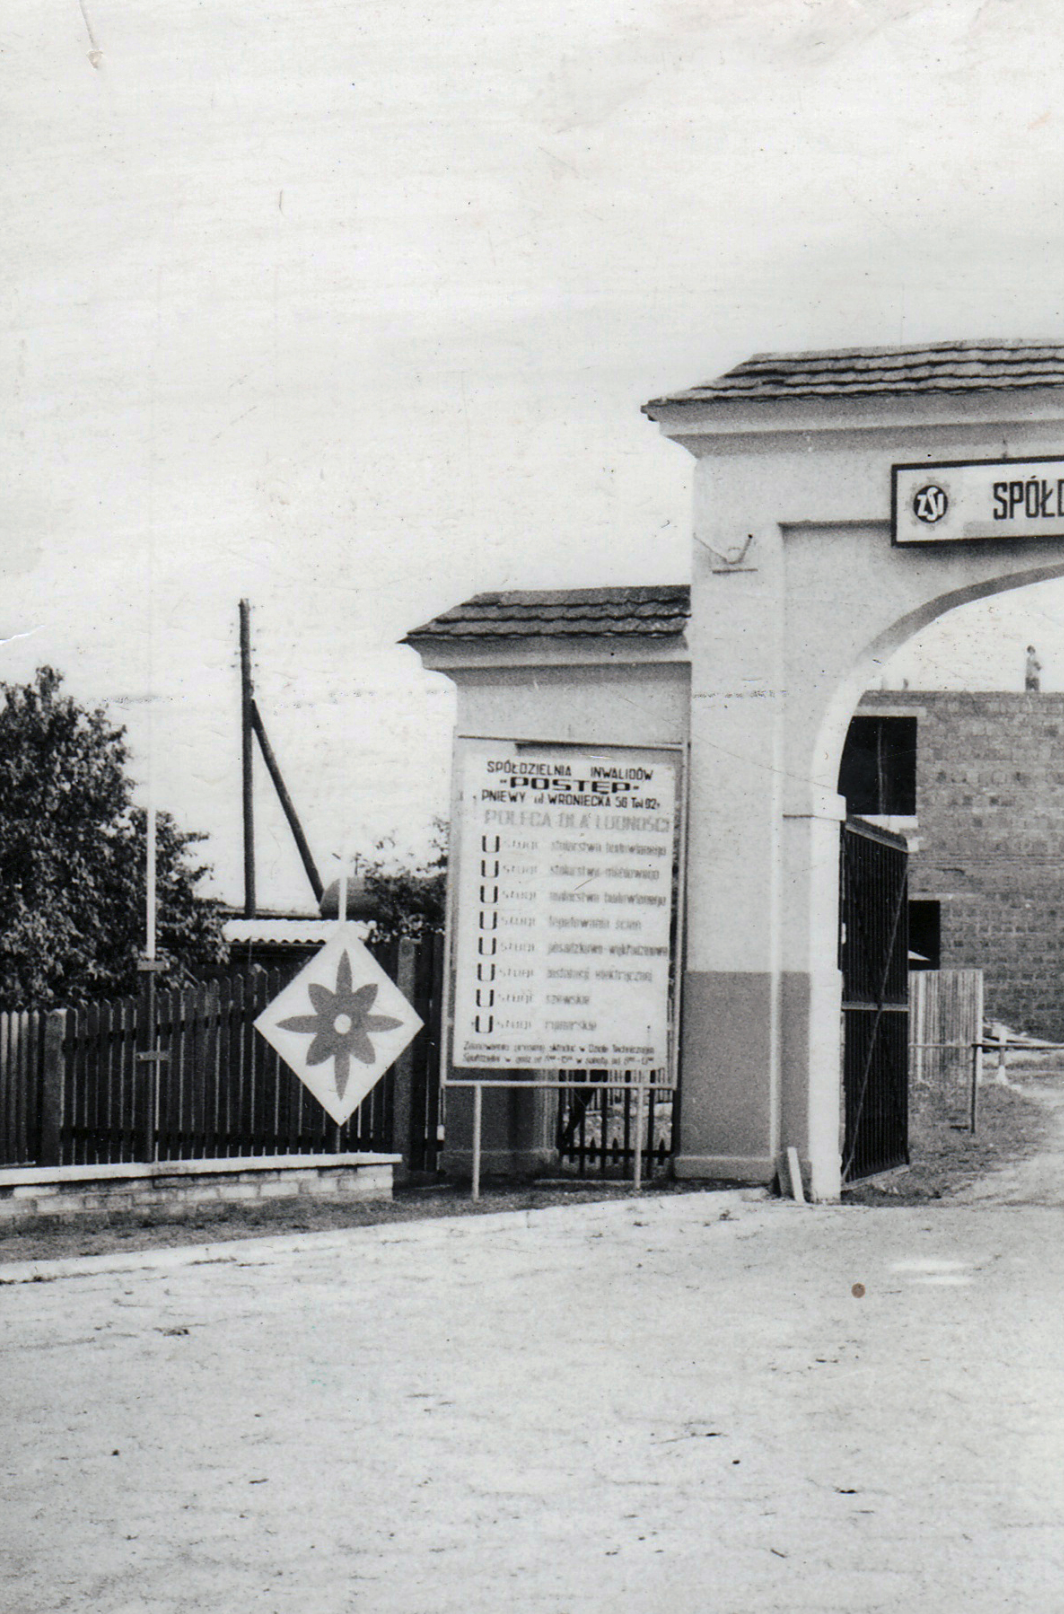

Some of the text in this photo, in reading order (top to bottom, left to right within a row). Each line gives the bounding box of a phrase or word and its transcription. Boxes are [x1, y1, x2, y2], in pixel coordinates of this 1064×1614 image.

[487, 760, 653, 781] SPÓŁDZIELNIA INWALIDÓW
[481, 789, 526, 804] PNIEWY
[547, 793, 611, 807] WRONIECKA
[485, 809, 670, 833] POLECA DLA LUDNOŚCI
